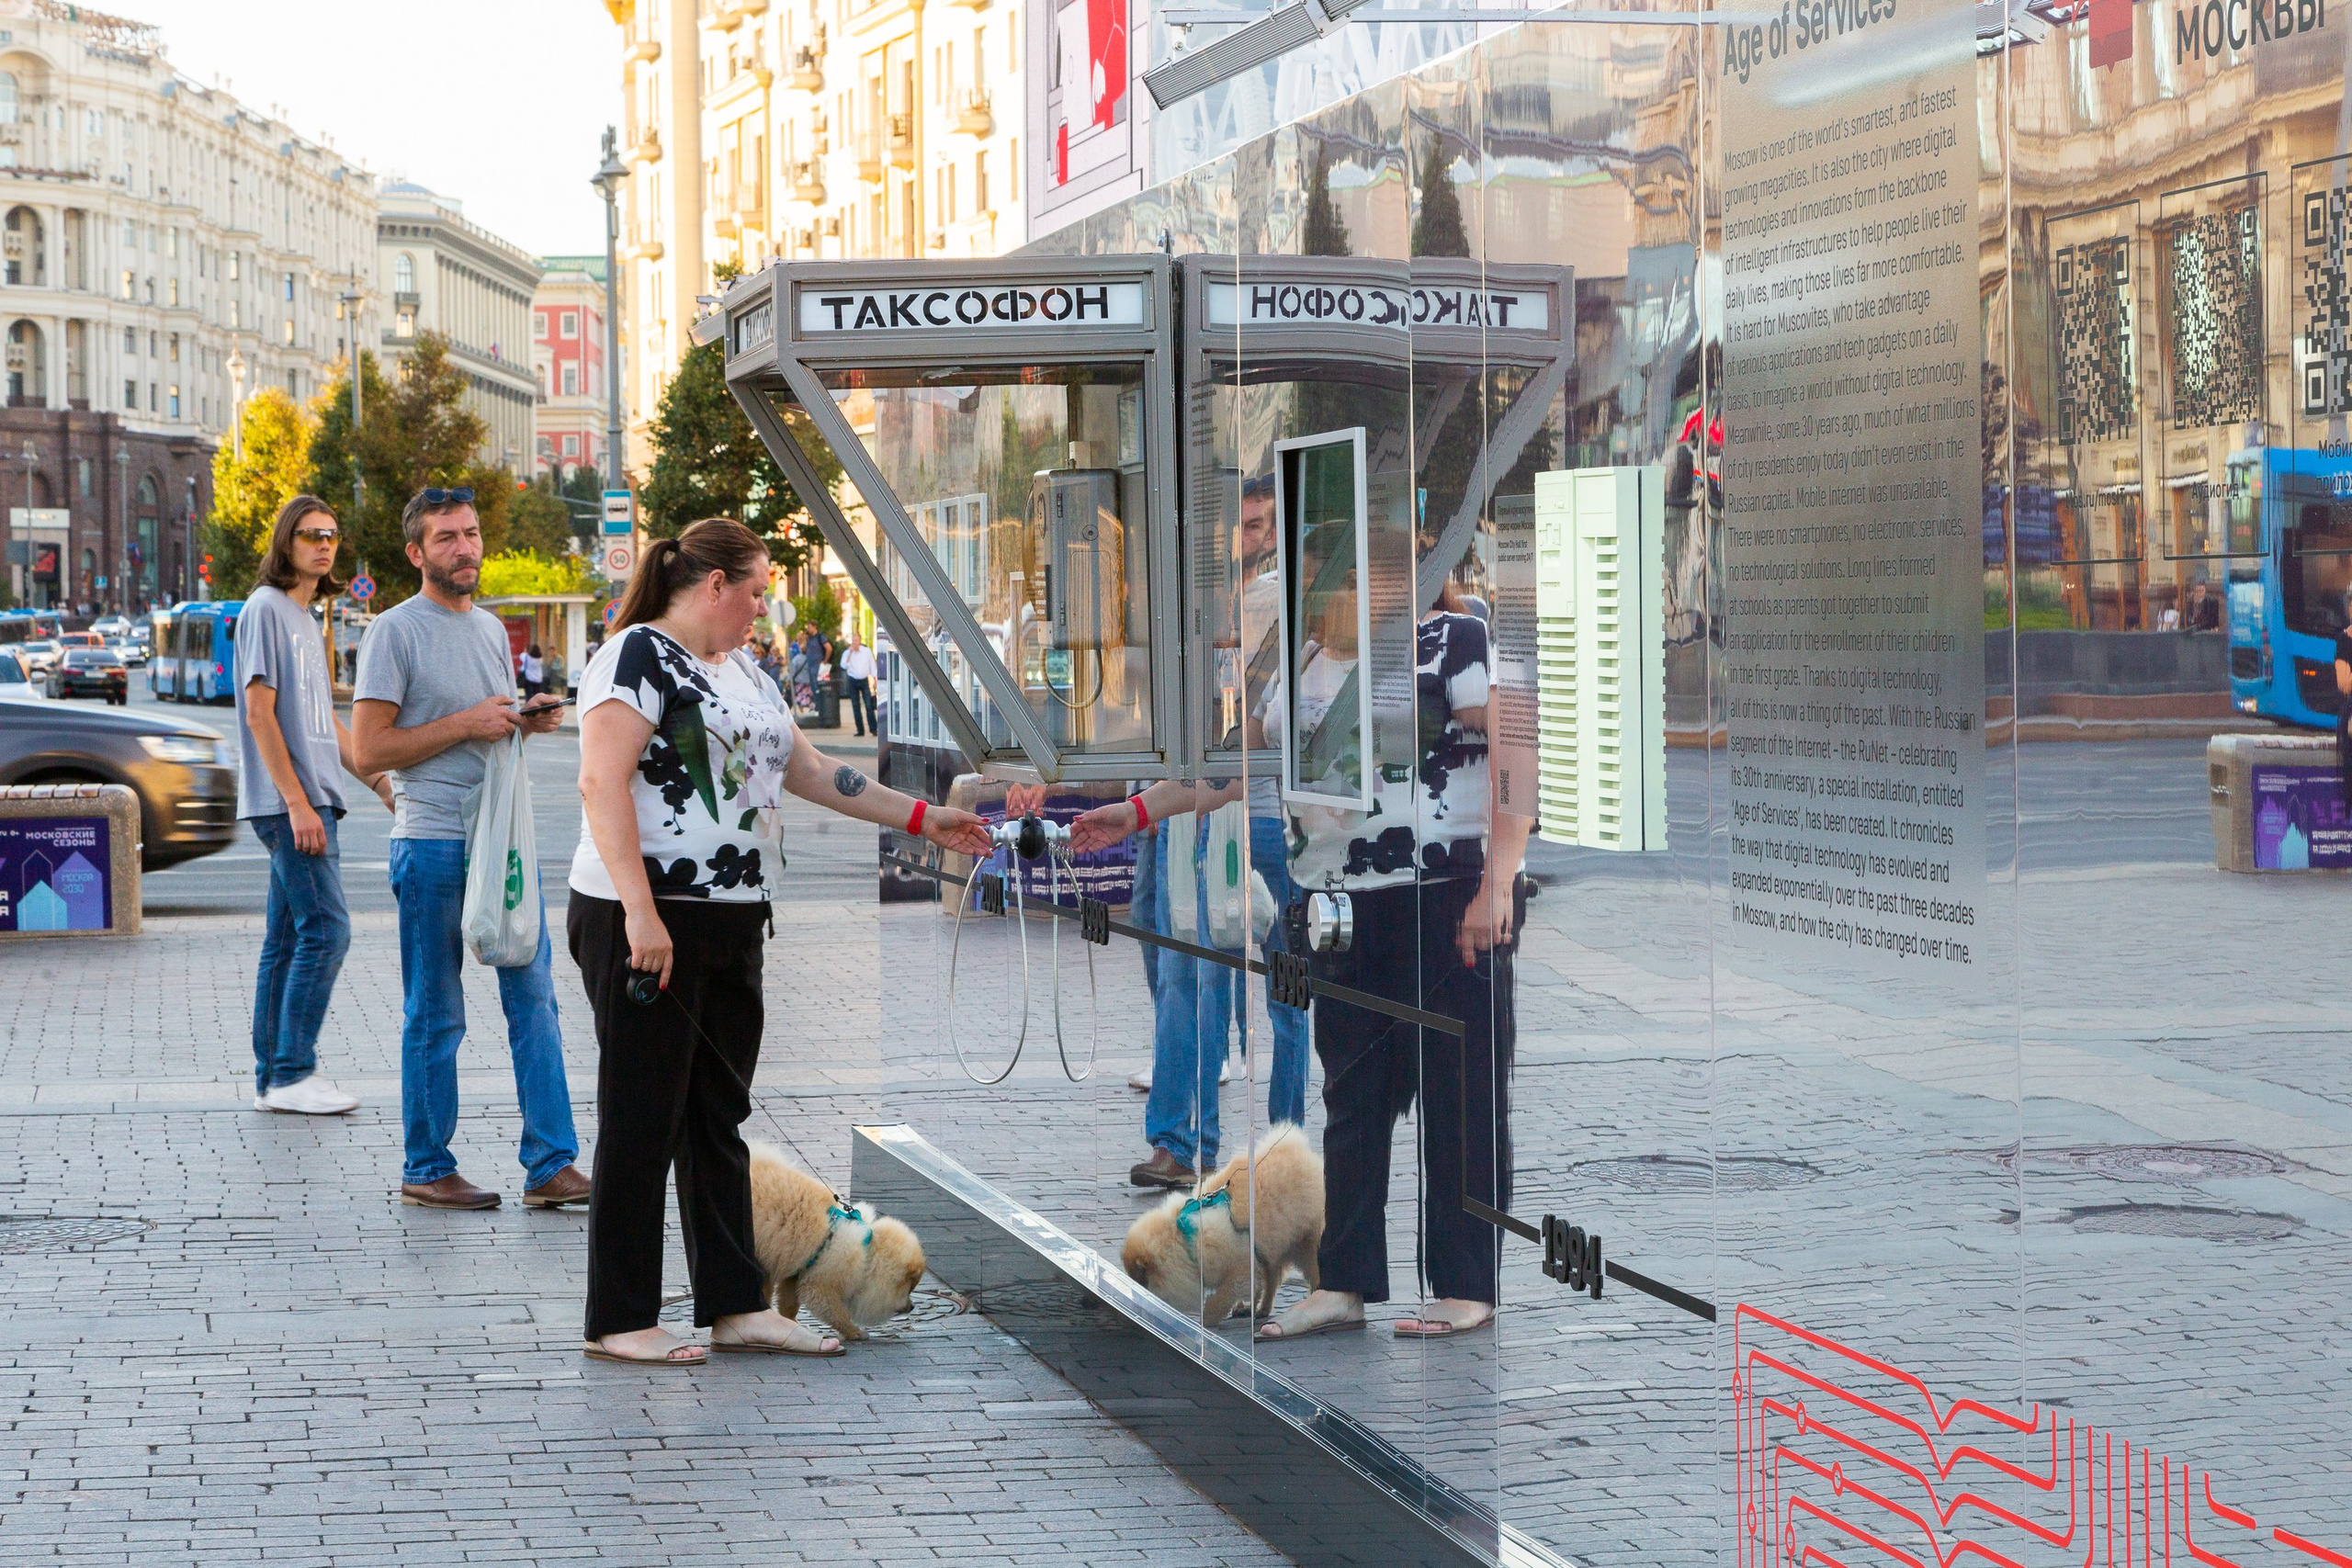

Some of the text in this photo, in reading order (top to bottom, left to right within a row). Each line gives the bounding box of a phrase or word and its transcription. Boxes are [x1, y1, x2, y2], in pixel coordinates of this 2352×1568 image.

[1724, 23, 1763, 85] Age
[1769, 2, 1790, 59] of
[2177, 0, 2324, 65] МОСКВЫ
[1724, 149, 1758, 172] Moscow
[1760, 141, 1767, 163] is
[1769, 141, 1784, 159] one
[1787, 131, 1796, 154] of
[1798, 128, 1812, 151] the
[1850, 105, 1895, 136] smartest,
[1899, 95, 1917, 121] and
[1920, 85, 1956, 116] fastest
[1724, 123, 1956, 213] growing megacities. It is also the city where digital
[1725, 169, 1946, 241] technologies and innovations form the backbone
[1725, 200, 1966, 275] of intelligent infrastructures to help people live their
[1725, 240, 1963, 312] daily lives, making those lives far more comfortable.
[820, 286, 1108, 330] ТАКСОФОН
[1726, 290, 1929, 343] It is hard for Muscovites, who take advantage
[1726, 318, 1958, 377] of various applications and tech gadgets on a daily
[1753, 389, 1761, 407] to
[1763, 381, 1797, 410] imagine
[1799, 385, 1804, 400] a
[1807, 375, 1832, 400] world
[1835, 371, 1870, 396] without
[1872, 364, 1904, 396] digital
[1776, 421, 1799, 439] some
[1802, 413, 1813, 436] 30
[1815, 416, 1839, 441] years
[1864, 404, 1890, 428] much
[1894, 402, 1903, 425] of
[1905, 400, 1930, 423] what
[1933, 395, 1974, 421] millions
[614, 555, 626, 563] 50
[1731, 734, 1956, 774] segment of the Internet the RuNet celebrating
[1731, 765, 1963, 807] its 30th anniversary, a special installation, entitled
[26, 831, 96, 840] МОСКОВСКИЕ
[1751, 802, 1759, 823] of
[1805, 807, 1821, 829] has
[1824, 809, 1846, 832] been
[1849, 815, 1887, 837] created.
[1890, 816, 1897, 839] It
[1900, 818, 1952, 844] chronicles
[1732, 833, 1949, 883] the way that digital technology has evolved and
[1733, 870, 1973, 924] expanded exponentially over the past three decades
[1733, 900, 1971, 964] in Moscow, and how the city has changed over time.
[1270, 950, 1309, 1010] 1996
[1542, 1213, 1603, 1300] 1994
